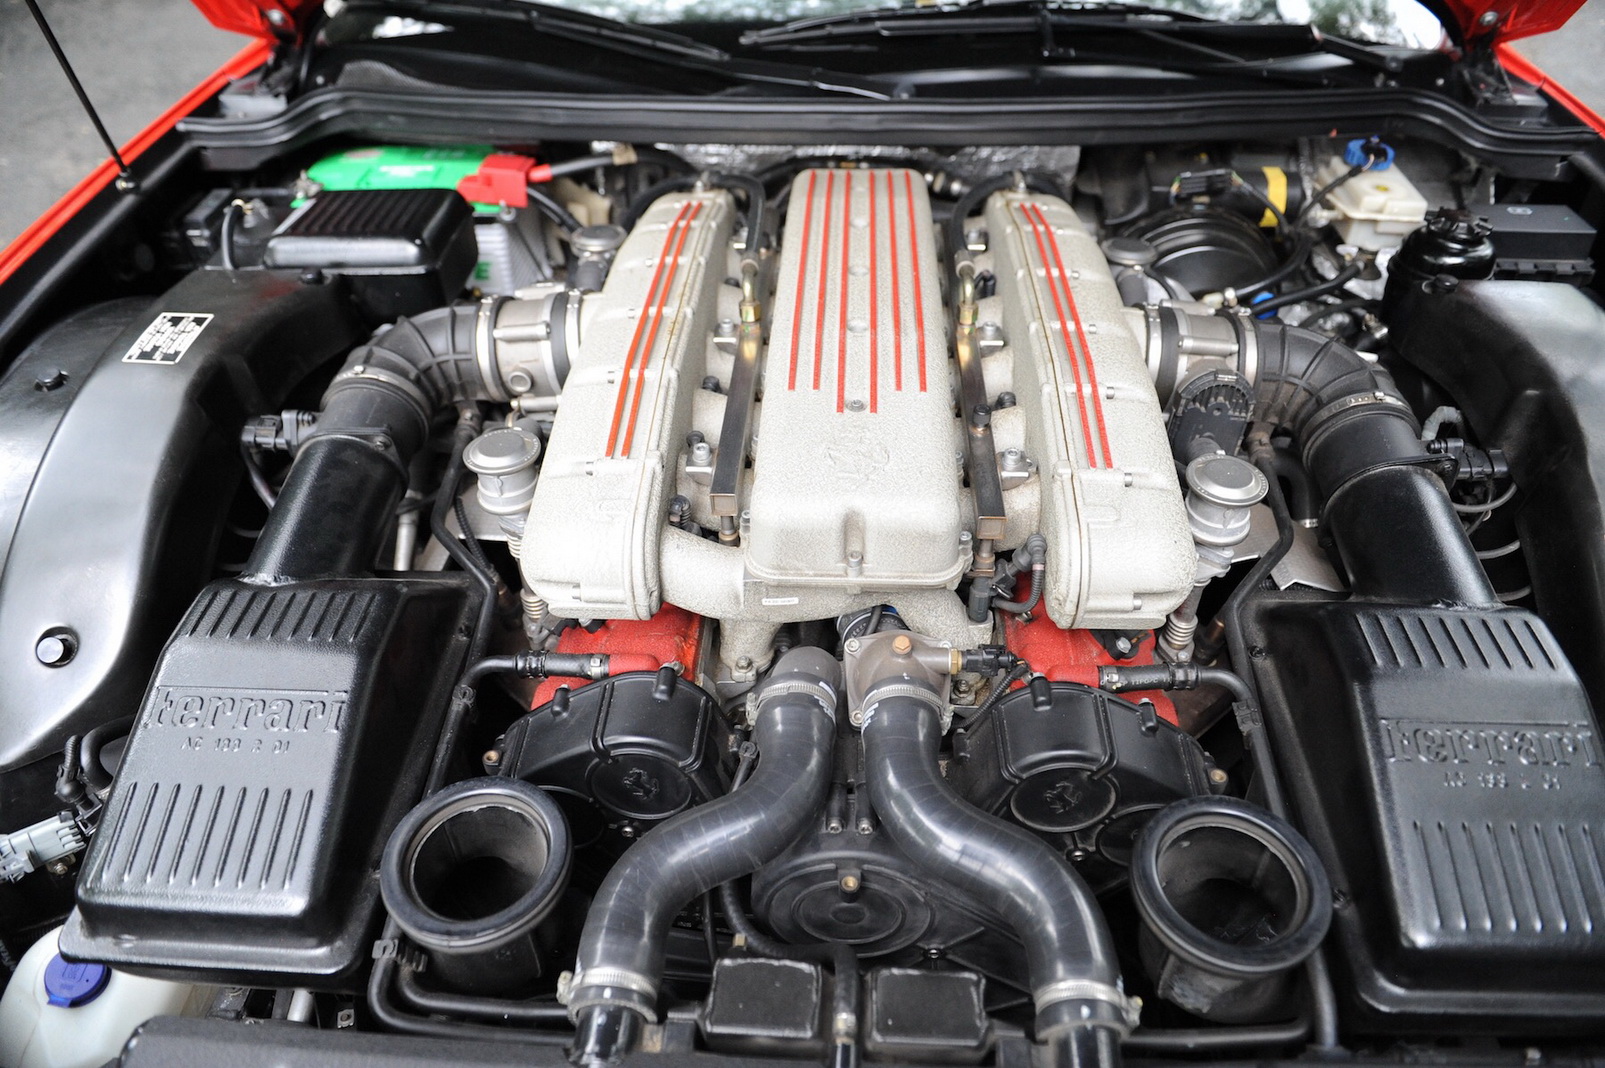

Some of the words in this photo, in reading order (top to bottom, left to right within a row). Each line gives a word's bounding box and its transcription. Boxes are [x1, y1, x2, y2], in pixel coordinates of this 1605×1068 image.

[144, 685, 348, 734] Ferrari
[180, 736, 204, 751] AC
[1380, 717, 1601, 767] Ferrari
